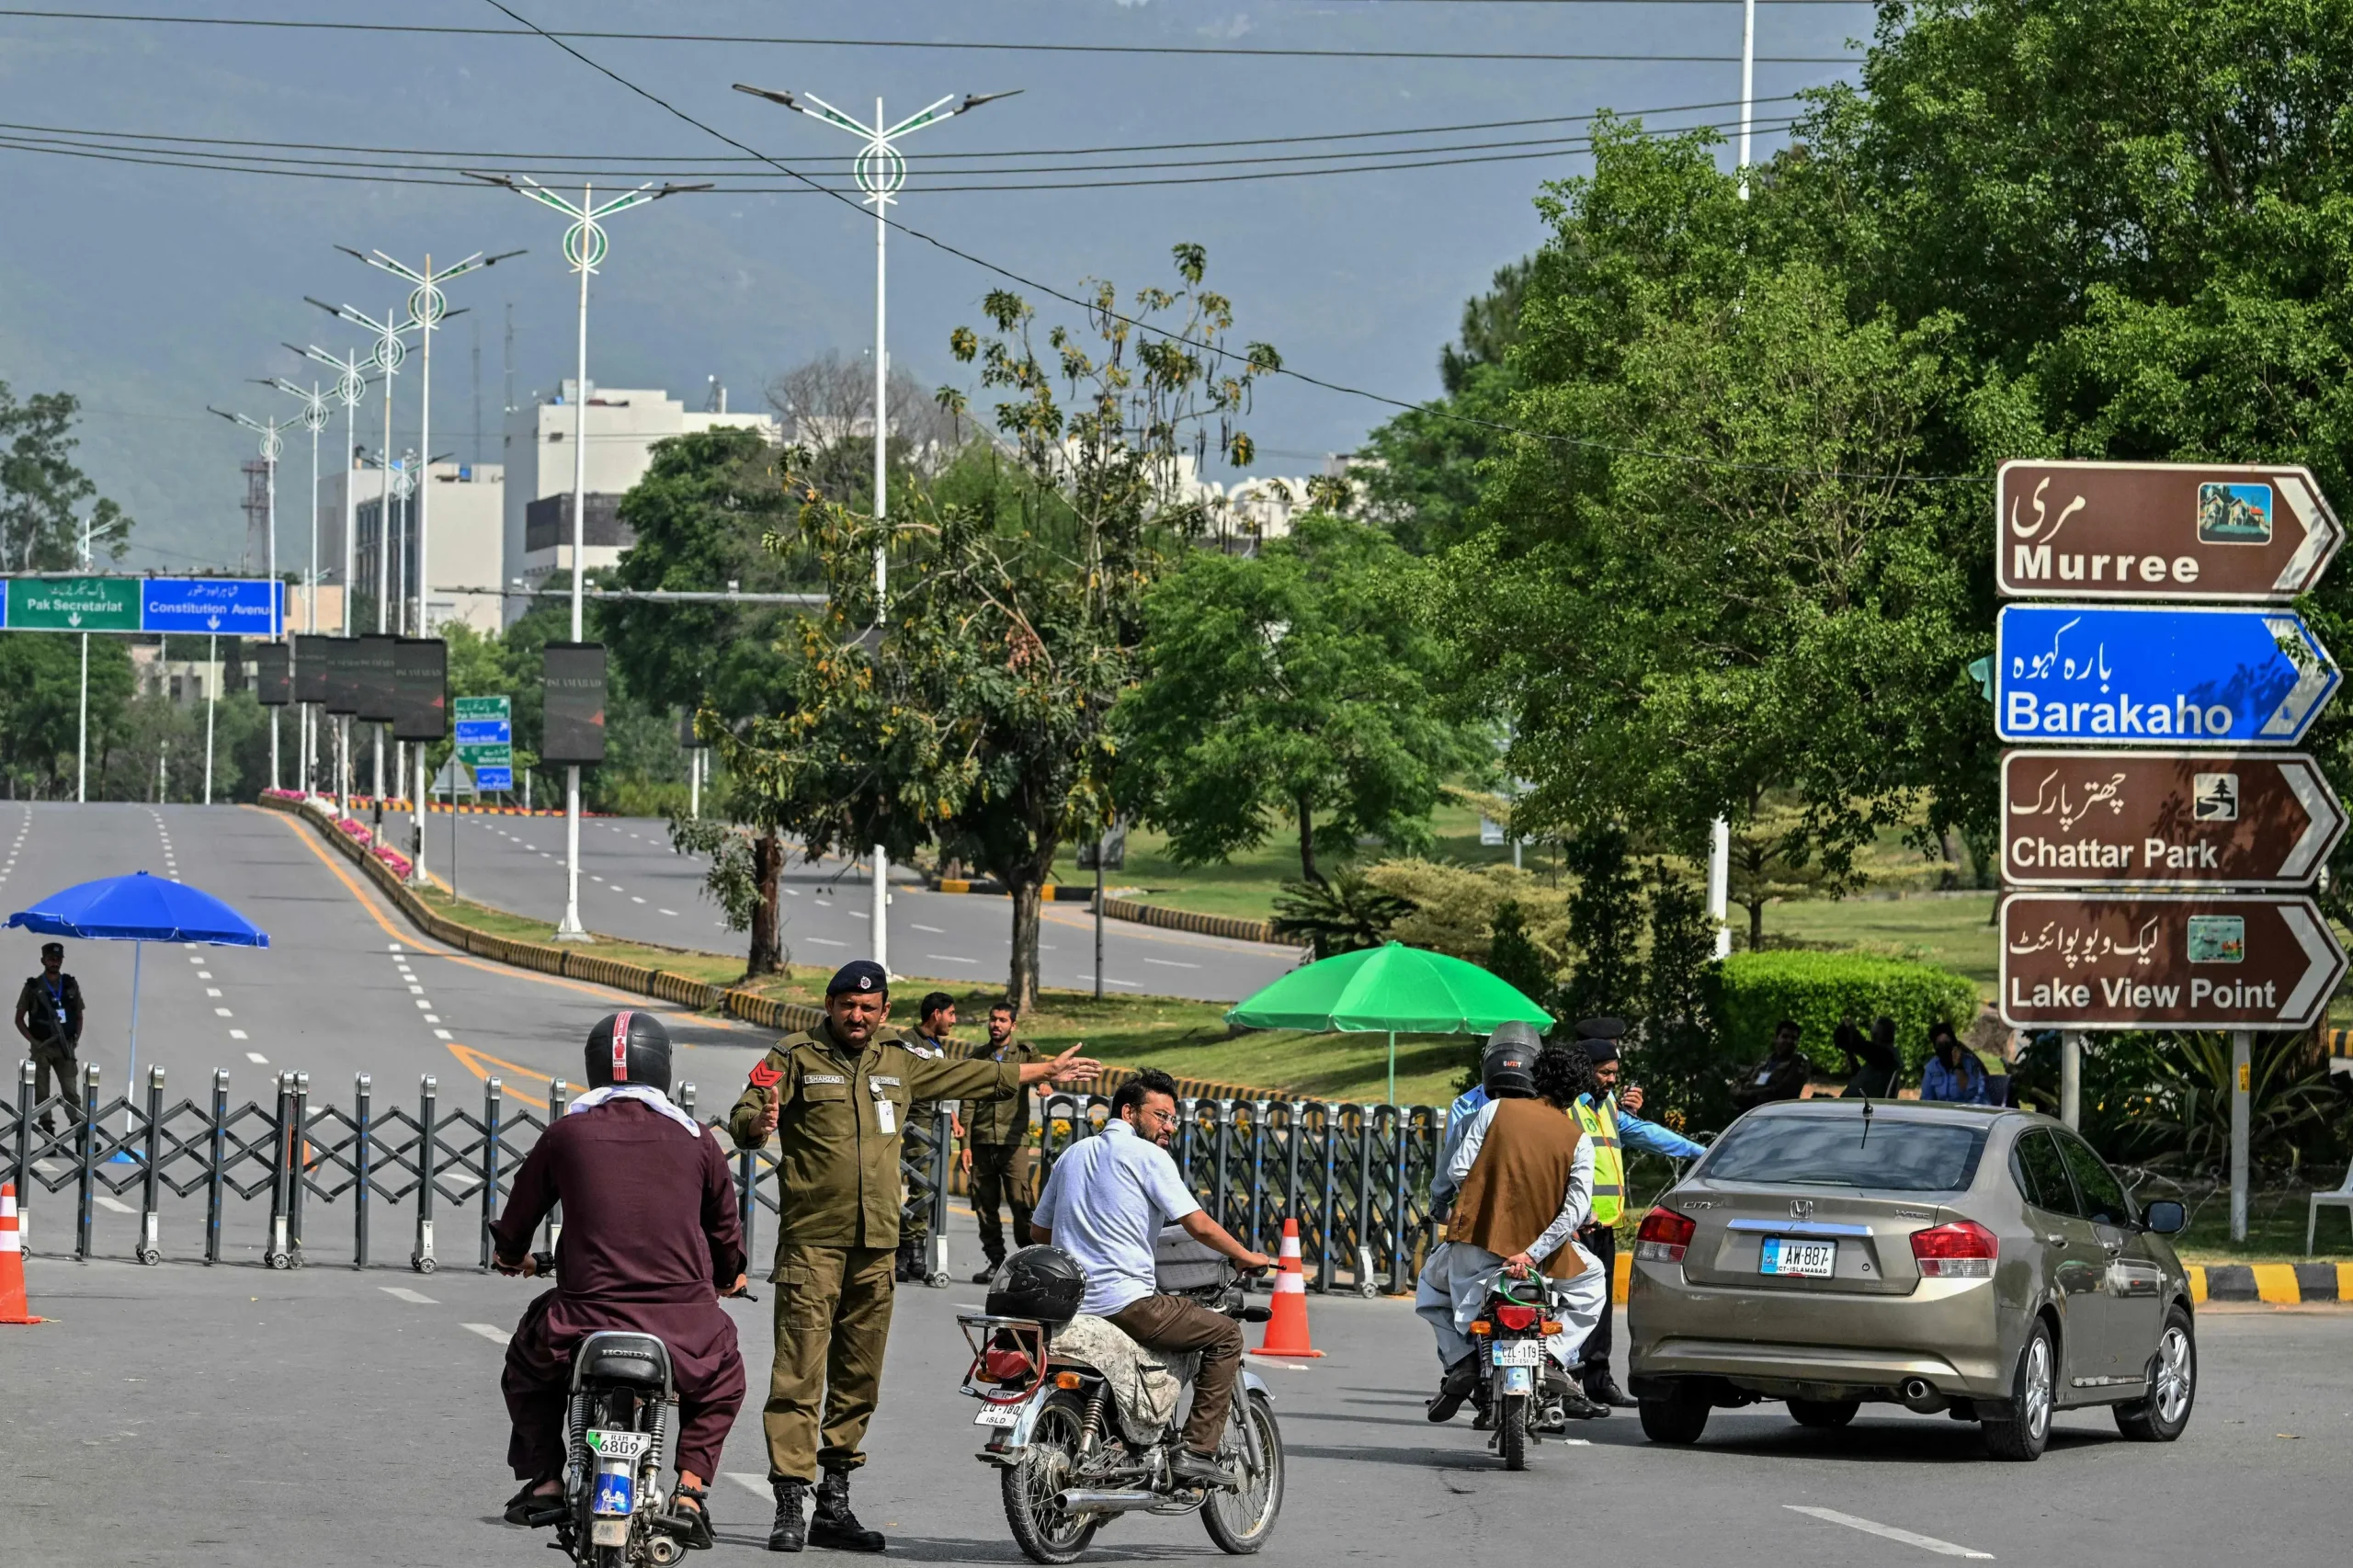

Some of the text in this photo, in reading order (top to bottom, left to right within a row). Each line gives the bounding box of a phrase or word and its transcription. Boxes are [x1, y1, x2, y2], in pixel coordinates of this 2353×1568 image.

[2011, 476, 2086, 544] مری
[2014, 544, 2200, 583] Murree
[28, 597, 122, 612] Pak Secretariat
[149, 601, 271, 616] Constitution Avenu
[2007, 691, 2233, 734] Barakaho
[2010, 768, 2127, 833] چھتر پارک
[2011, 836, 2218, 869] Chattar Park
[2011, 977, 2276, 1009] Lake View Point
[1683, 1200, 1714, 1210] CITY
[1777, 1266, 1827, 1274] ICT-ISLAMABAD
[602, 1349, 654, 1359] HONDA
[985, 1416, 1006, 1425] ISLD
[599, 1439, 639, 1455] 6809
